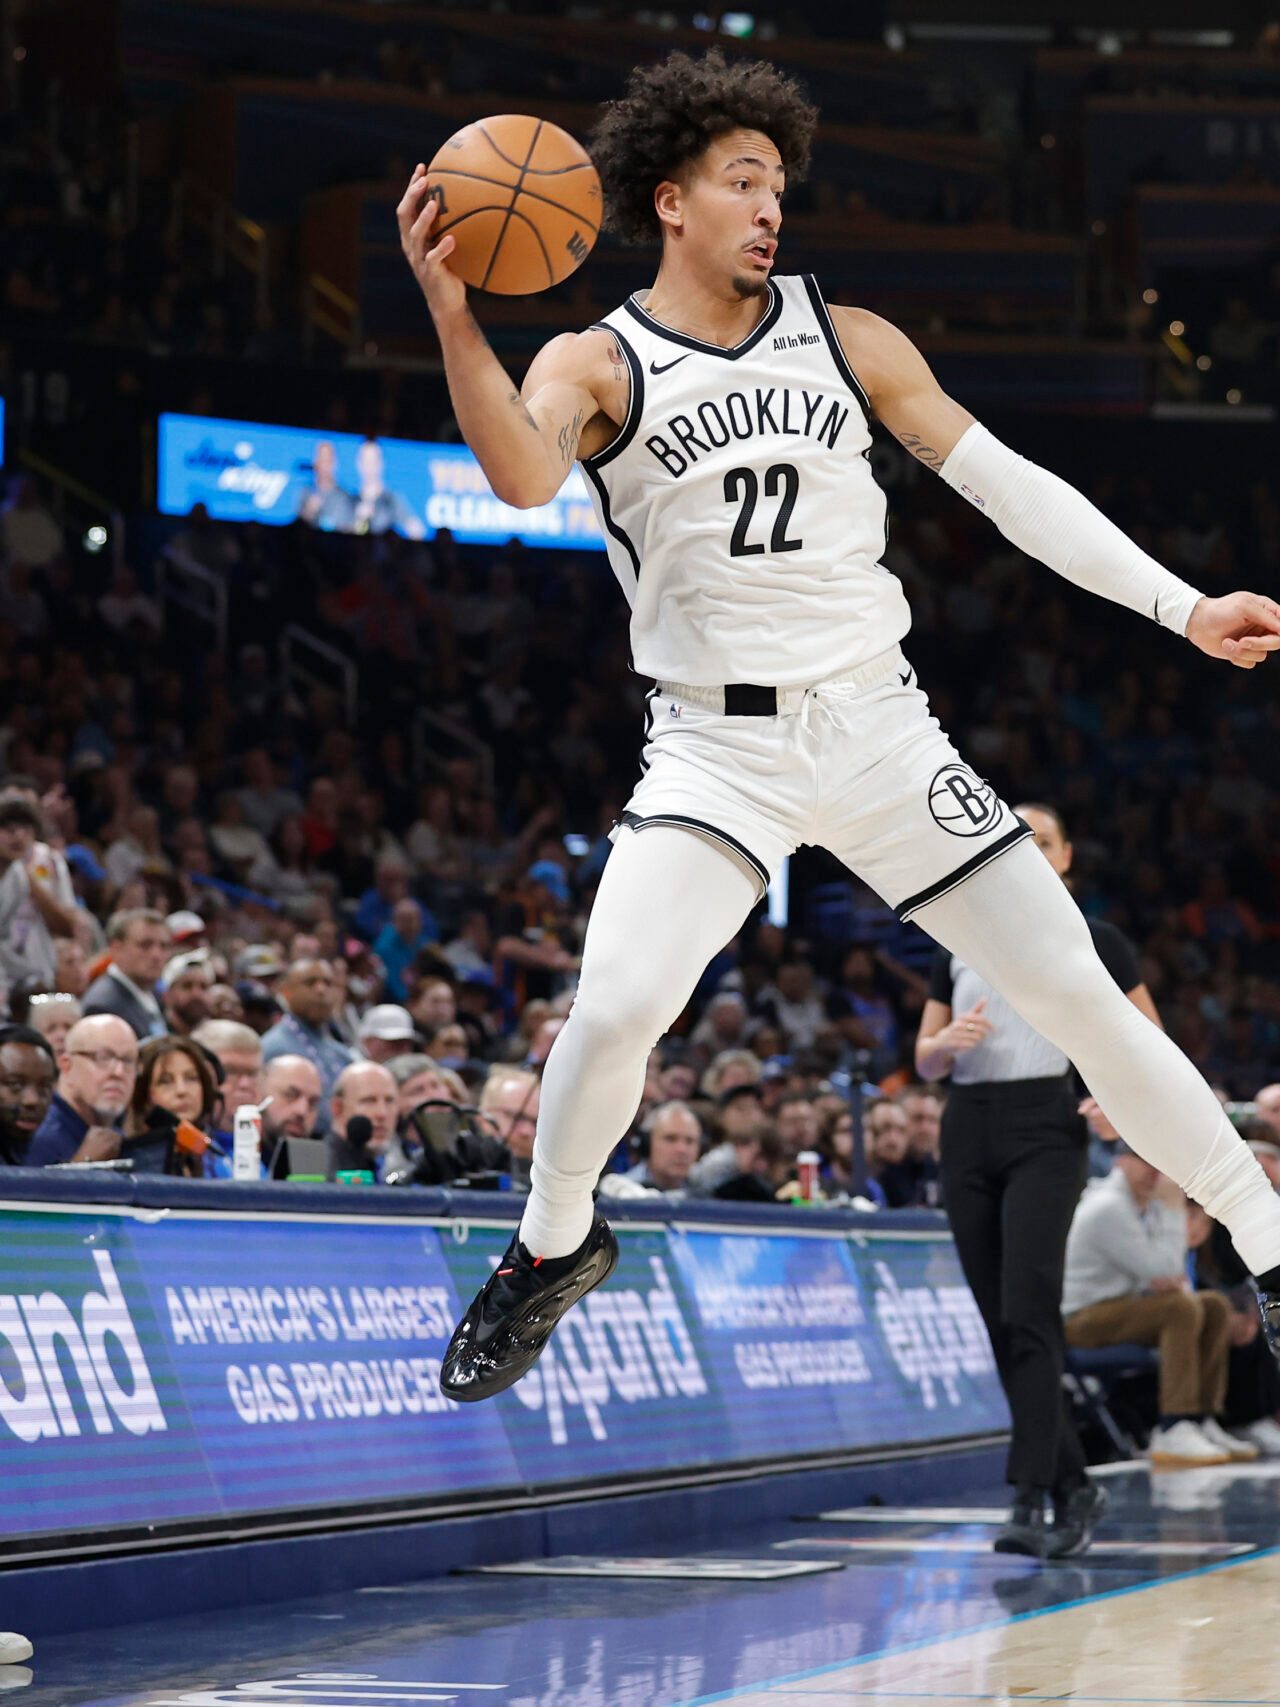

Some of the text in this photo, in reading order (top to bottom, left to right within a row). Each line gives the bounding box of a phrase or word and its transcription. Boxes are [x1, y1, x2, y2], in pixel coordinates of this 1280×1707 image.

[773, 332, 820, 351] All In Won
[645, 388, 849, 479] BROOKLYN
[723, 463, 803, 558] 22
[944, 774, 989, 826] B
[164, 1285, 456, 1345] AMERICA'S LARGEST
[225, 1363, 300, 1424] GAS
